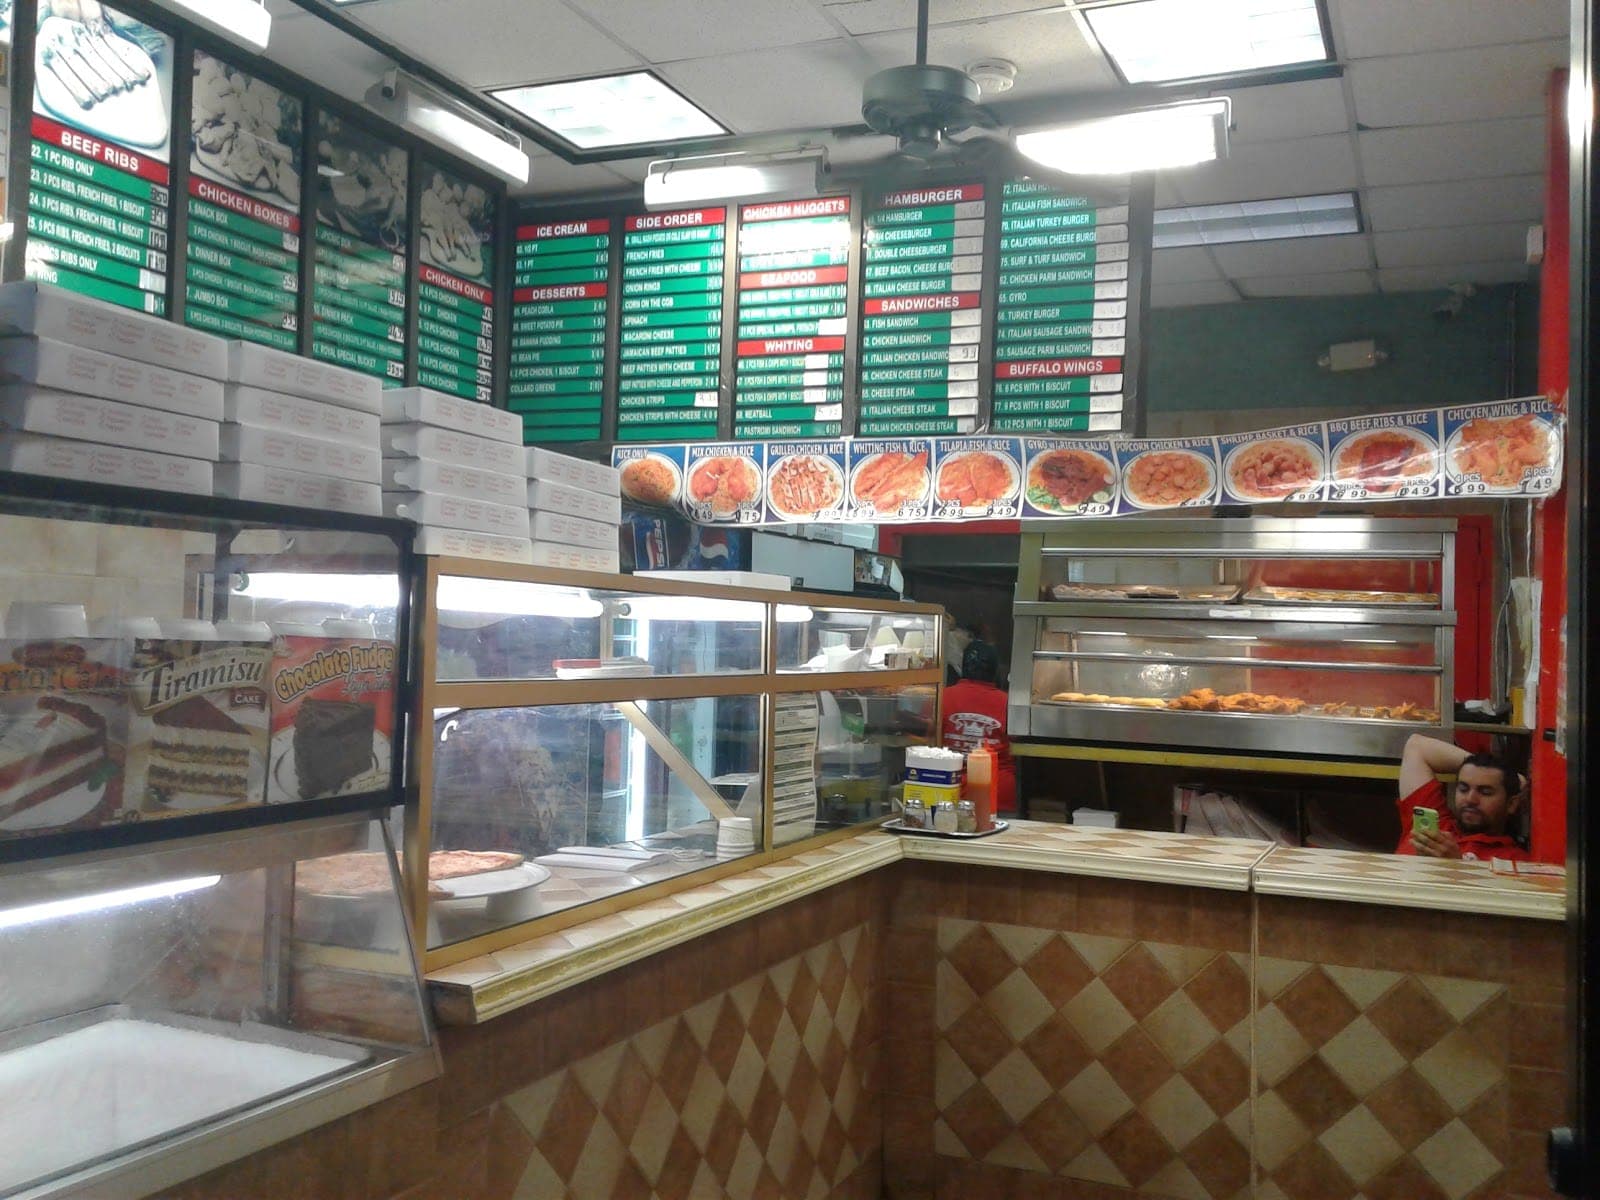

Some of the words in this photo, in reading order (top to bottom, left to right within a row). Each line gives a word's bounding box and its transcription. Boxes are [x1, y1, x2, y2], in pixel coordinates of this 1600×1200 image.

[61, 131, 101, 156] BEEF
[105, 147, 138, 171] RIBS
[50, 152, 60, 165] PC
[62, 155, 74, 168] RIB
[76, 160, 94, 176] ONLY
[1013, 184, 1036, 193] ITALIAN
[77, 184, 100, 201] FRENCH
[124, 201, 144, 217] BISCUIT
[885, 189, 962, 205] HAMBURGER
[198, 183, 251, 213] CHICKEN
[254, 206, 289, 228] BOXES
[744, 206, 791, 218] CHICKEN
[794, 200, 845, 215] NUGGETS
[1012, 201, 1035, 211] ITALIAN
[1037, 200, 1051, 209] FISH
[1053, 197, 1087, 208] SANDWICH
[216, 211, 228, 224] BOX
[636, 217, 661, 228] SIDE
[664, 213, 702, 225] ORDER
[886, 211, 922, 221] HAMBURGER
[1011, 219, 1035, 230] ITALIAN
[1037, 217, 1061, 227] TURKEY
[1063, 214, 1089, 224] BURGER
[76, 206, 99, 224] FRENCH
[122, 223, 144, 240] BISCUIT
[537, 226, 552, 237] ICE
[554, 223, 587, 235] CREAM
[885, 228, 932, 241] CHEESEBURGER
[72, 229, 94, 246] FRENCH
[1011, 236, 1048, 247] CALIFORNIA
[1050, 233, 1074, 245] CHEESE
[875, 247, 898, 259] DOUBLE
[899, 245, 946, 257] CHEESEBURGER
[61, 250, 78, 266] RIBS
[79, 256, 97, 271] ONLY
[219, 254, 230, 266] BOX
[1011, 257, 1026, 266] SURF
[1035, 255, 1050, 264] TURF
[1052, 252, 1085, 262] SANDWICH
[875, 266, 889, 276] BEEF
[914, 263, 936, 273] CHEESE
[761, 270, 816, 286] SEAFOOD
[1010, 273, 1037, 284] CHICKEN
[1040, 272, 1056, 281] PARM
[1058, 270, 1092, 280] SANDWICH
[426, 270, 463, 292] CHICKEN
[464, 285, 484, 299] ONLY
[874, 284, 895, 294] ITALIAN
[897, 282, 920, 292] CHEESE
[921, 280, 945, 290] BURGER
[533, 287, 585, 300] DESSERTS
[1009, 292, 1027, 302] GYRO
[217, 295, 228, 308] BOX
[882, 296, 959, 312] SANDWICHES
[1008, 310, 1032, 320] TURKEY
[1034, 309, 1060, 318] BURGER
[873, 319, 885, 328] FISH
[887, 317, 918, 327] SANDWICH
[1008, 328, 1032, 338] ITALIAN
[1034, 327, 1062, 337] SAUSAGE
[765, 340, 813, 352] WHITING
[872, 335, 898, 346] CHICKEN
[900, 334, 931, 344] SANDWICH
[1008, 346, 1036, 356] SAUSAGE
[1038, 345, 1055, 355] PARM
[1057, 343, 1091, 354] SANDWICH
[871, 354, 893, 363] ITALIAN
[895, 352, 920, 362] CHICKEN
[1010, 363, 1061, 375] BUFFALO
[1064, 360, 1103, 372] WINGS
[871, 370, 898, 380] CHICKEN
[900, 369, 922, 379] CHEESE
[923, 369, 942, 378] STEAK
[871, 388, 894, 398] CHEESE
[896, 387, 915, 397] STEAK
[1010, 383, 1023, 392] PCS
[1024, 382, 1040, 391] WITH
[1046, 381, 1071, 390] BISCUIT
[869, 406, 891, 415] ITALIAN
[892, 405, 916, 415] CHEESE
[917, 404, 936, 413] STEAK
[1009, 402, 1021, 410] PCS
[1023, 401, 1038, 410] WITH
[1045, 400, 1070, 409] BISCUIT
[1448, 407, 1488, 419] CHICKEN
[1492, 403, 1518, 416] WING
[1531, 400, 1552, 413] RICE
[870, 424, 887, 432] ITALIAN
[888, 423, 913, 432] CHICKEN
[915, 422, 938, 431] CHEESE
[939, 421, 954, 430] STEAK
[1013, 420, 1025, 428] PCS
[1026, 419, 1042, 428] WITH
[1048, 418, 1073, 427] BISCUIT
[1330, 422, 1348, 433] BBQ
[1350, 419, 1369, 430] BEEF
[1374, 417, 1394, 428] RIBS
[1406, 413, 1428, 424] RICE
[1221, 434, 1252, 445] SHRIMP
[1257, 430, 1288, 440] BASKET
[1298, 425, 1319, 435] RICE
[692, 448, 704, 457] MIX
[706, 447, 732, 457] CHICKEN
[740, 446, 754, 456] RICE
[771, 444, 797, 455] GRILLED
[798, 444, 822, 455] CHICKEN
[830, 444, 844, 454] RICE
[854, 442, 884, 454] WHITING
[886, 442, 900, 453] FISH
[909, 442, 925, 452] RICE
[941, 440, 967, 451] TILAPIA
[969, 440, 985, 450] FISH
[994, 440, 1010, 450] RICE
[1028, 441, 1048, 450] GYRO
[1085, 441, 1108, 451] SALAD
[1116, 442, 1149, 452] POPCORN
[1151, 441, 1183, 450] CHICKEN
[1193, 439, 1211, 447] RICE
[141, 657, 264, 709] Tiramisu
